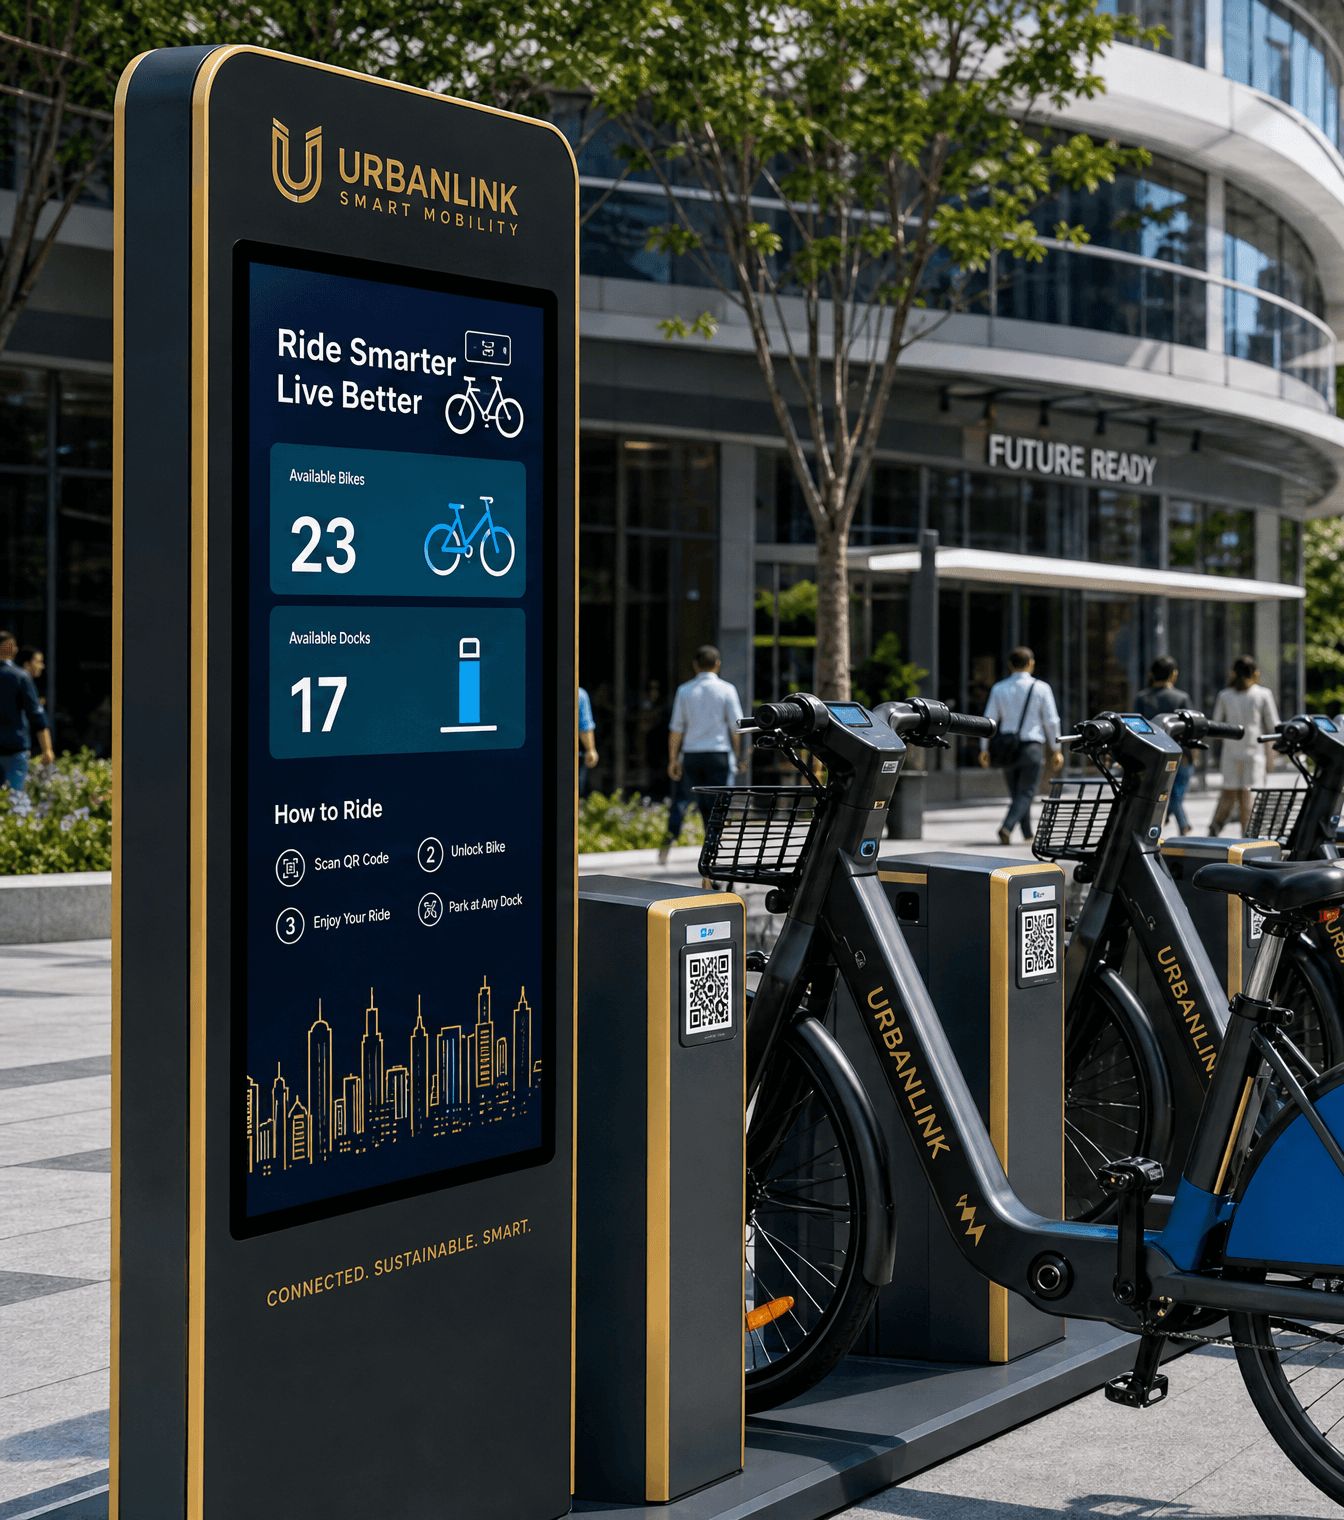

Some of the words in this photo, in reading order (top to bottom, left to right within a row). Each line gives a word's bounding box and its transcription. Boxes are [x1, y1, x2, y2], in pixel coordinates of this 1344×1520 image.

[339, 147, 519, 216] URBANLINK
[340, 191, 411, 217] SMART
[424, 206, 518, 236] MOBILITY
[278, 327, 342, 363] Ride
[349, 337, 457, 377] Smarter
[277, 373, 334, 407] Live
[342, 380, 423, 415] Better
[289, 468, 337, 485] Available
[338, 471, 366, 486] Bikes
[989, 434, 1085, 478] FUTURE
[1091, 448, 1157, 486] READY
[291, 515, 356, 574] 23
[289, 630, 337, 645] Available
[339, 630, 371, 645] Docks
[291, 676, 348, 733] 17
[274, 804, 315, 825] How
[320, 802, 339, 822] to
[343, 798, 383, 820] Ride
[314, 857, 341, 871] Scan
[343, 854, 360, 869] QR
[362, 851, 390, 866] Code
[426, 845, 436, 864] 2
[451, 842, 484, 858] Unlock
[485, 840, 506, 854] Bike
[285, 916, 296, 935] 3
[313, 914, 342, 931] Enjoy
[343, 911, 366, 925] Your
[368, 908, 391, 922] Ride
[449, 899, 469, 913] Park
[470, 898, 480, 911] at
[481, 897, 499, 911] Any
[500, 893, 523, 907] Dock
[1157, 945, 1217, 1080] URBANLIN
[867, 985, 951, 1160] URBANLINK
[266, 1265, 369, 1307] CONNECTED.
[374, 1233, 478, 1276] SUSTAINABLE.
[482, 1218, 532, 1245] SMART.
